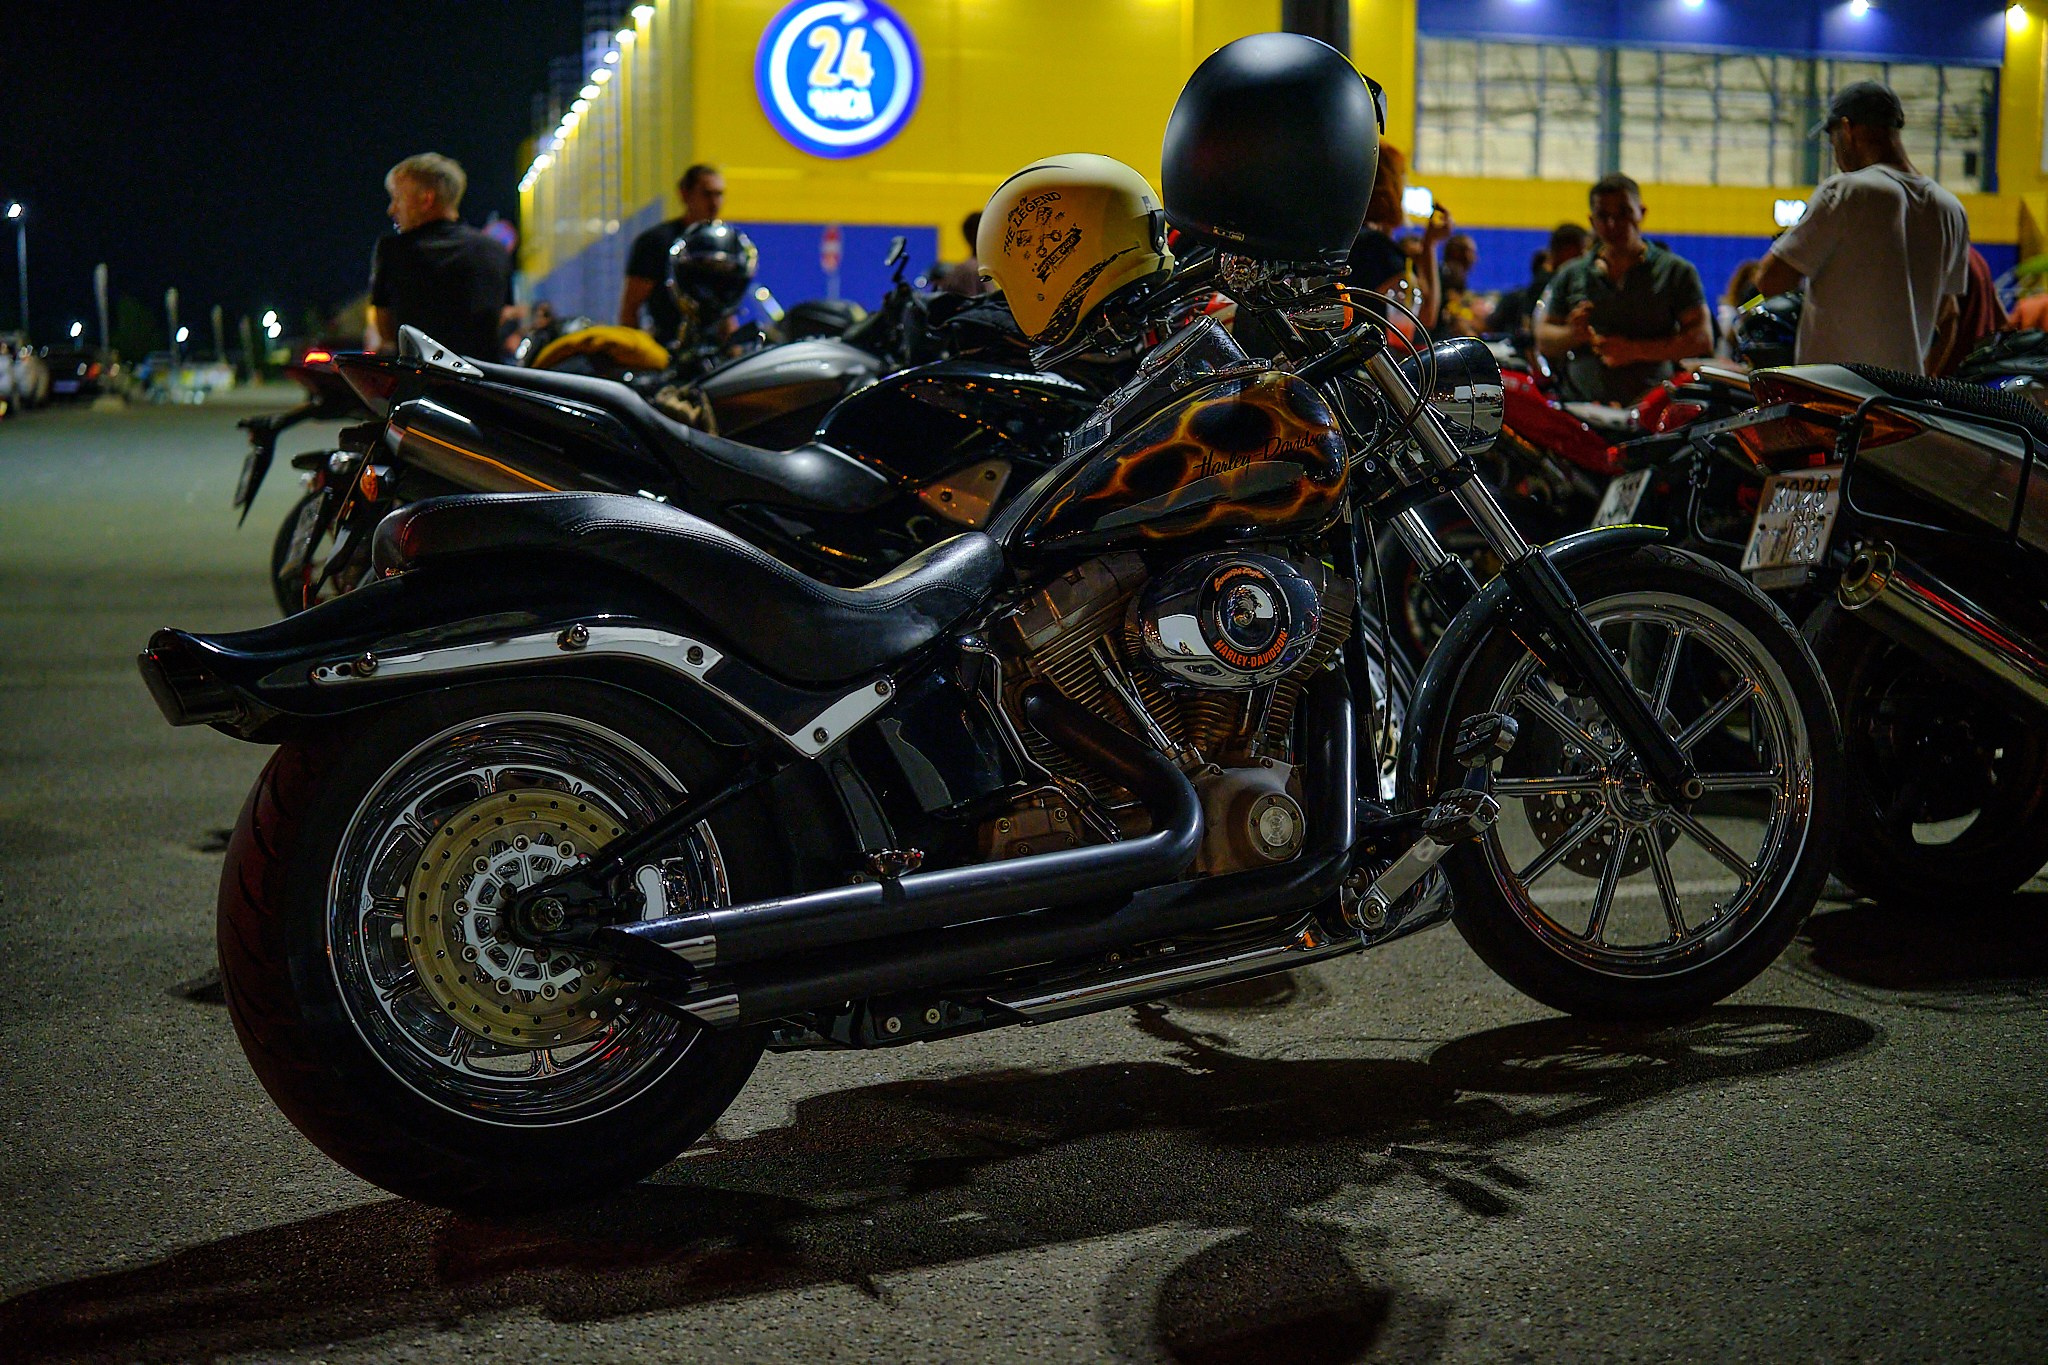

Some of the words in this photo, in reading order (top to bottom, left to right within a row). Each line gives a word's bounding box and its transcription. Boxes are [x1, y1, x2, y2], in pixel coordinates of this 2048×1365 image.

[808, 25, 875, 87] 24
[1003, 226, 1016, 257] THE
[1012, 191, 1062, 228] LEGEND
[1213, 630, 1289, 668] HARLEY-DAVIDSON
